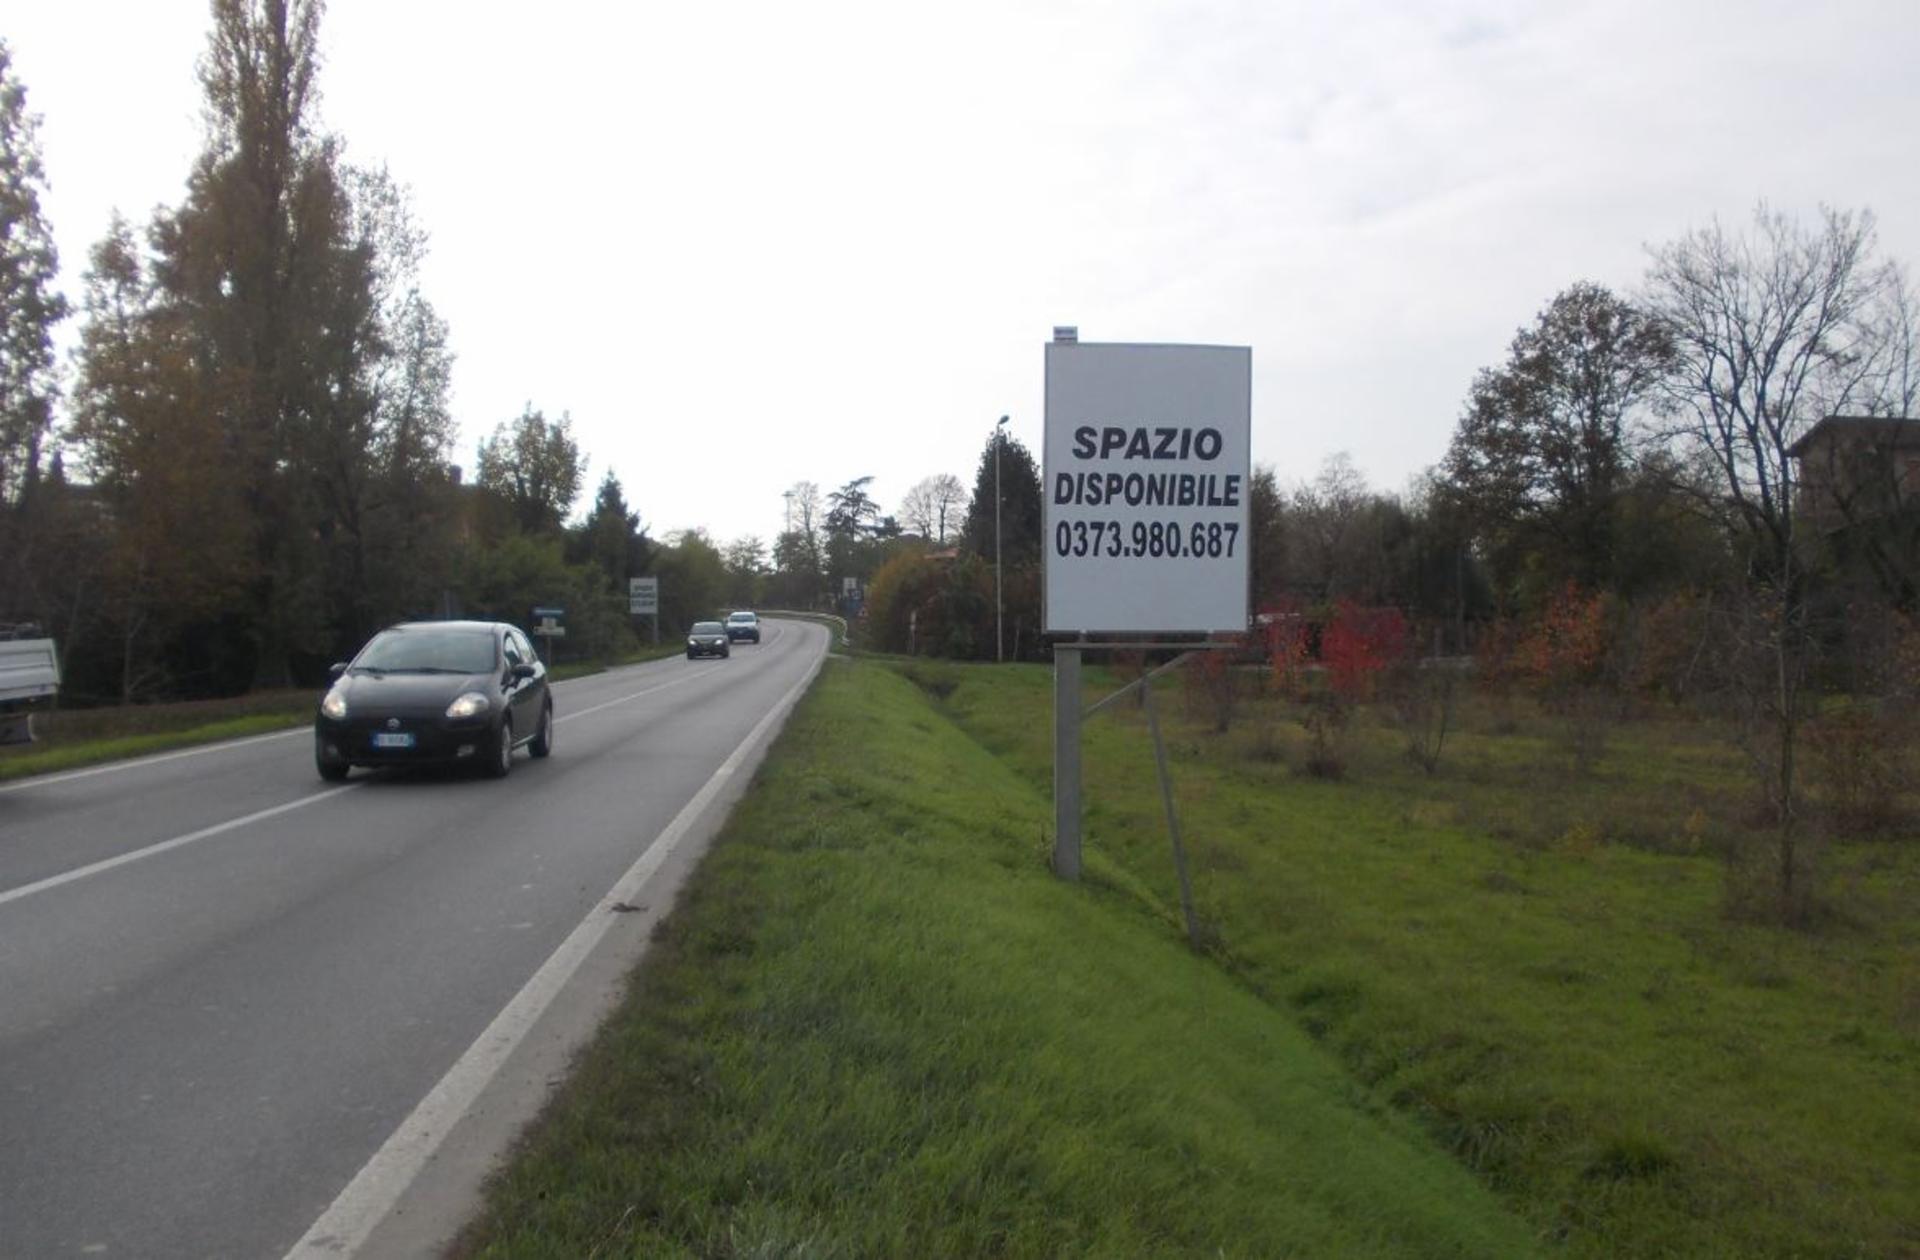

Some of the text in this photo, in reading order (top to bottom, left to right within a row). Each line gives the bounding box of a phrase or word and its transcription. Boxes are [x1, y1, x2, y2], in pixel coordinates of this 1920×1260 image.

[1072, 426, 1223, 461] SPAZIO
[1054, 472, 1241, 507] DISPONIBILE
[1055, 520, 1240, 558] 0373.980.687
